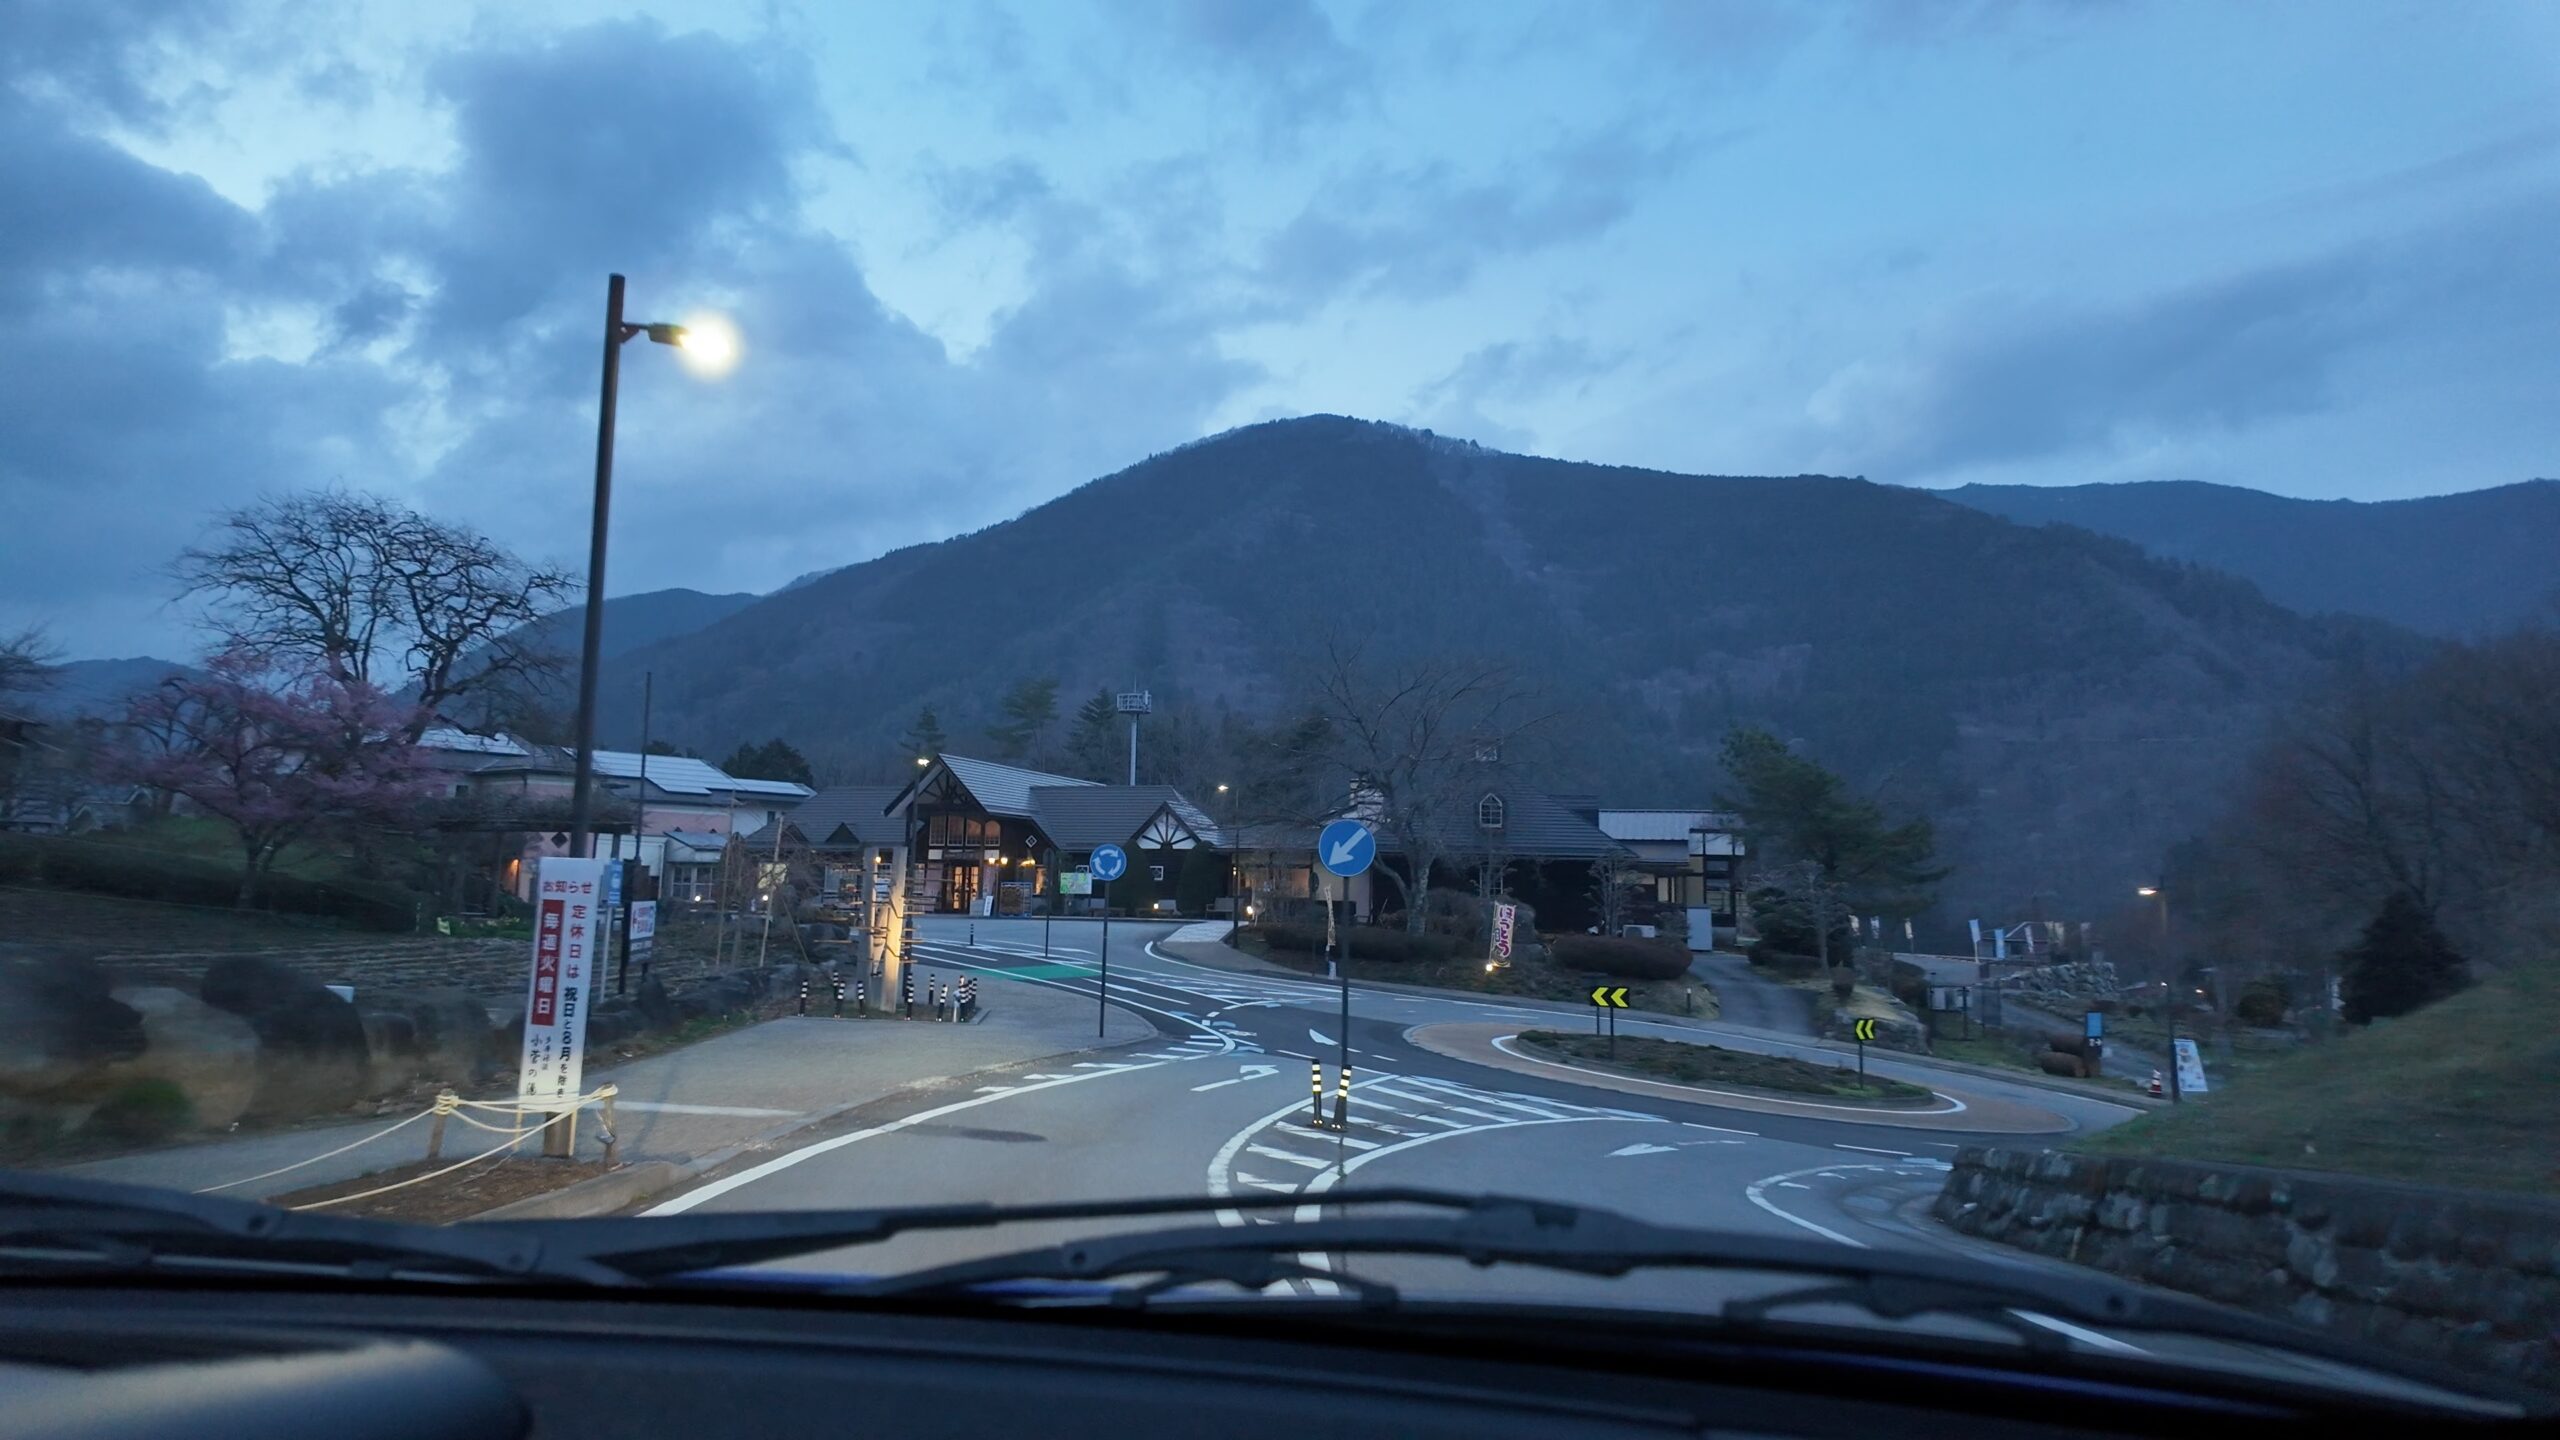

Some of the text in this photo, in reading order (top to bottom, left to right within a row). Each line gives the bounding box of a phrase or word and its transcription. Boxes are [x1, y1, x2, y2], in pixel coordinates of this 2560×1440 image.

[543, 880, 593, 894] お知らせ
[1499, 907, 1513, 956] ほうとう
[538, 912, 560, 1015] 毎週火曜日
